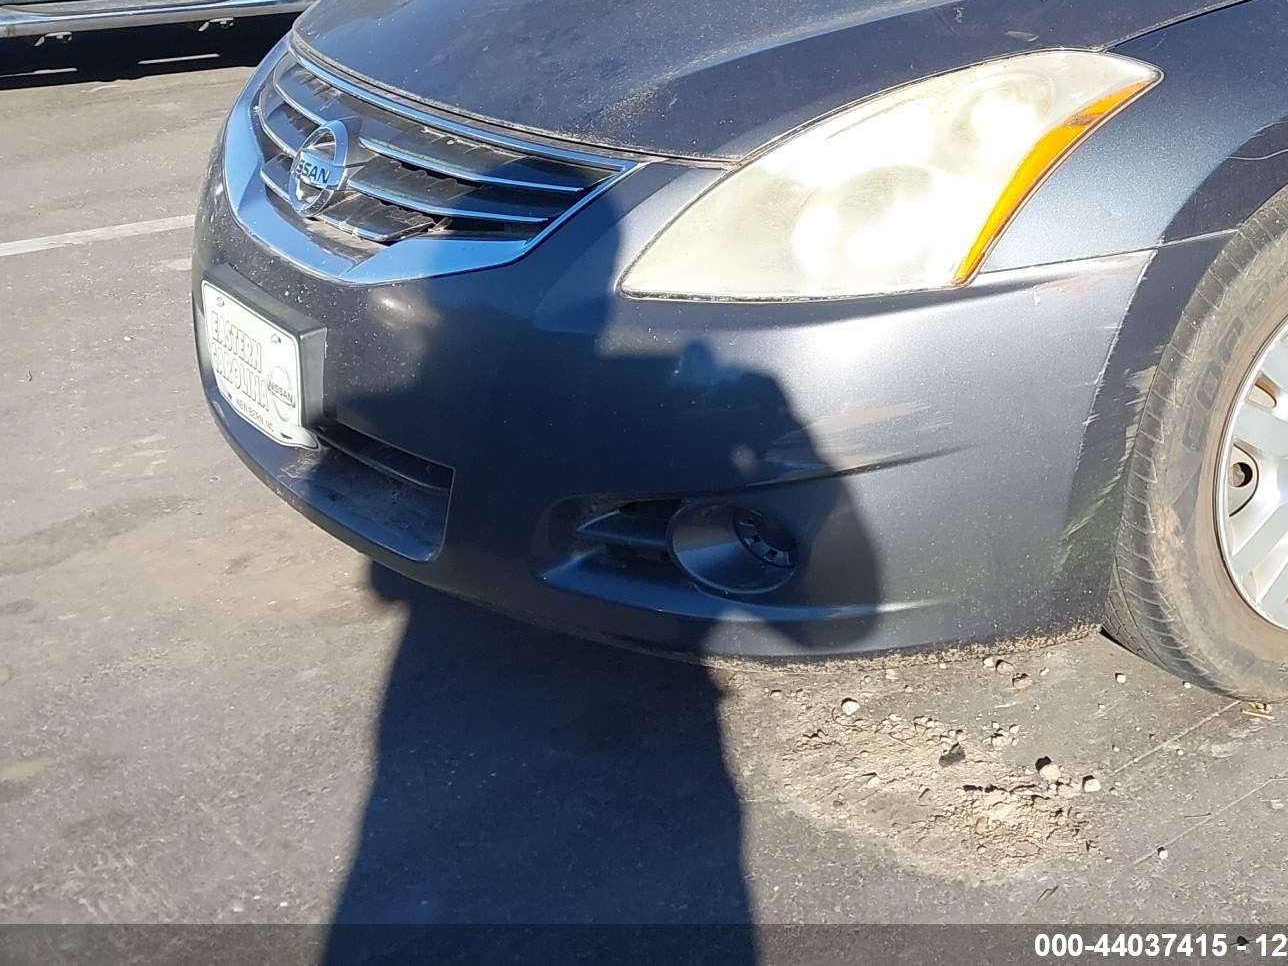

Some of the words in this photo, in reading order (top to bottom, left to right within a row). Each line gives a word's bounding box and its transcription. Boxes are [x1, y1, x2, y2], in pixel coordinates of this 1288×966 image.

[211, 310, 262, 374] EASTERN
[210, 342, 270, 412] CAROLINA
[267, 377, 294, 404] NISSAN
